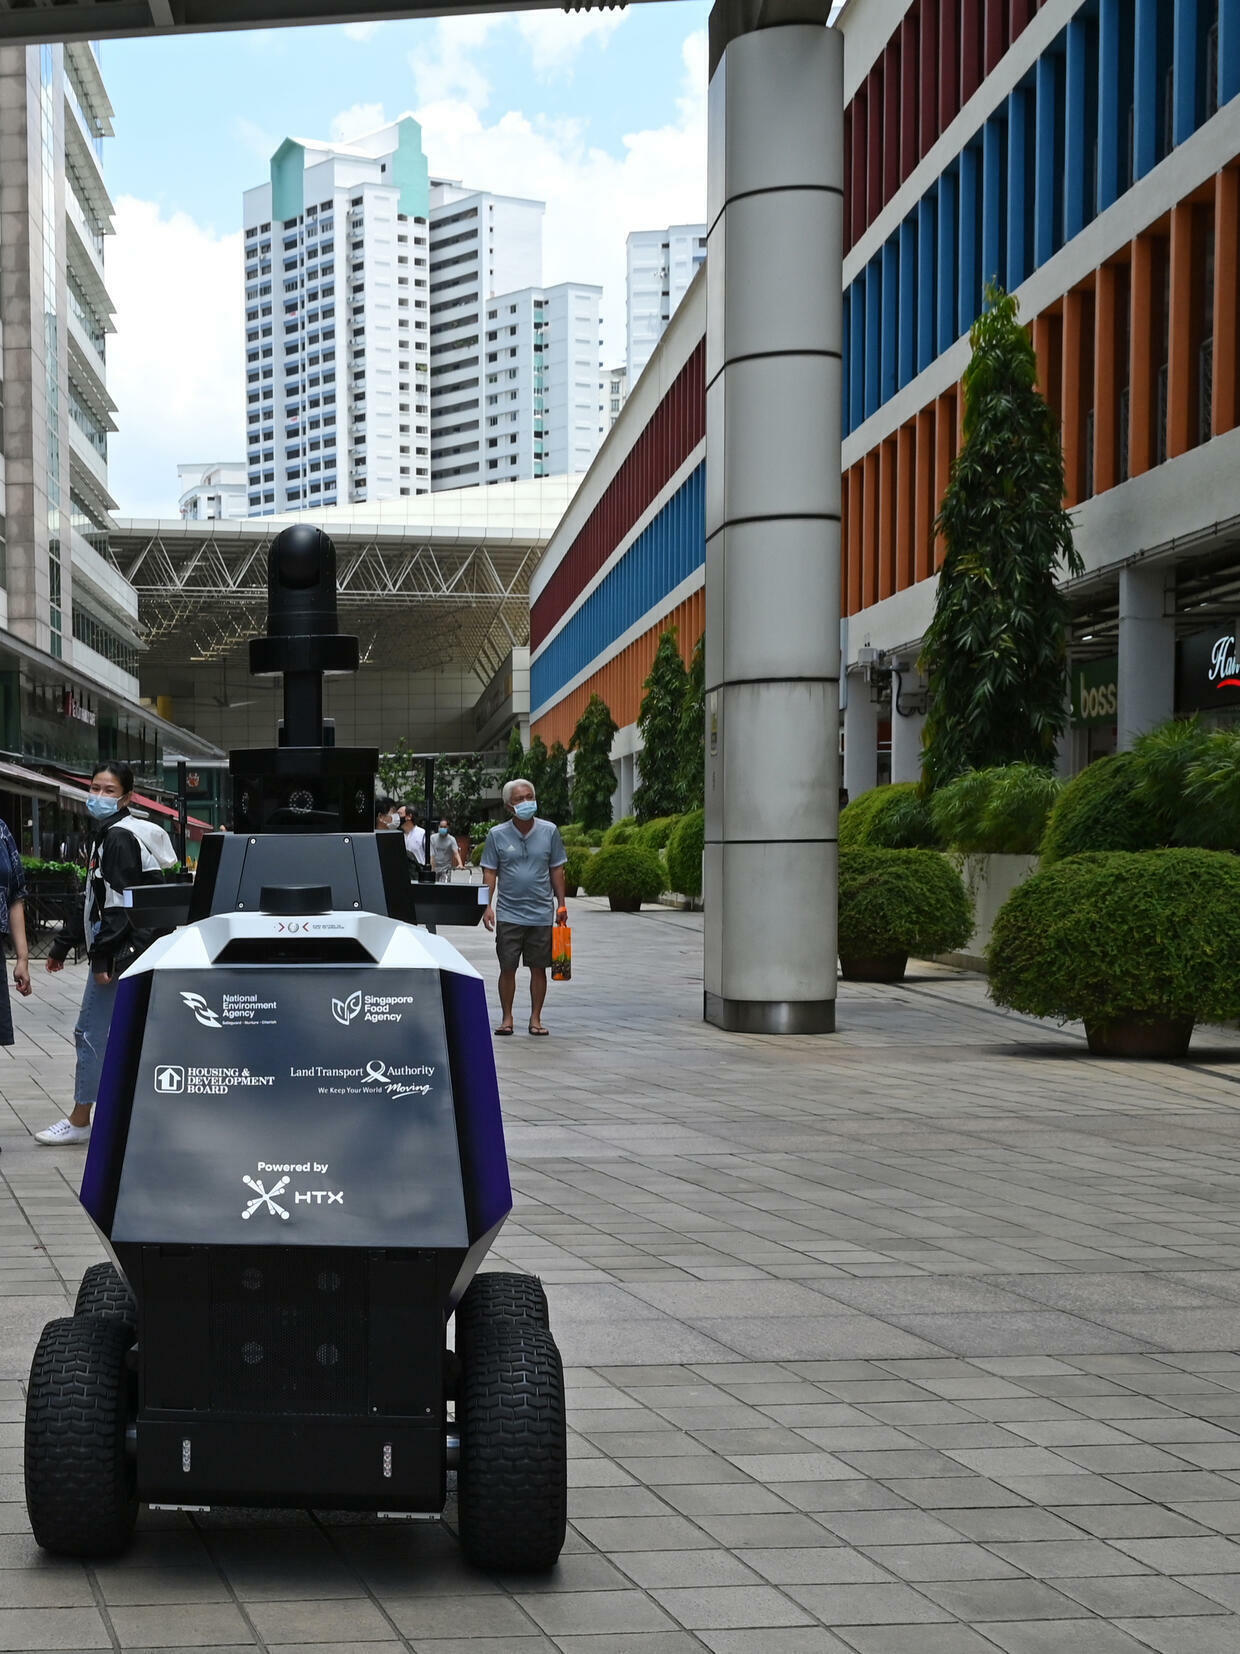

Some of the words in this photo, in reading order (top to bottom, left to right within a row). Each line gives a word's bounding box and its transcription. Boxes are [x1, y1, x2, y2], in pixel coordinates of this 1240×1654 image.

[223, 994, 258, 1002] National
[364, 995, 414, 1005] Singapore
[223, 1001, 277, 1010] Environment
[364, 1004, 389, 1013] Food
[222, 1009, 255, 1019] Agency
[364, 1013, 402, 1023] Agency
[187, 1067, 239, 1077] HOUSING
[241, 1068, 250, 1077] &
[290, 1066, 315, 1077] Land
[316, 1066, 364, 1079] Transport
[387, 1064, 435, 1077] Authority
[187, 1076, 275, 1085] DEVELOPMENT
[187, 1085, 228, 1094] BOARD
[330, 1087, 346, 1095] Keep
[385, 1082, 434, 1097] Moving
[257, 1161, 311, 1172] Powered
[313, 1162, 329, 1174] by
[294, 1191, 344, 1204] HTX
